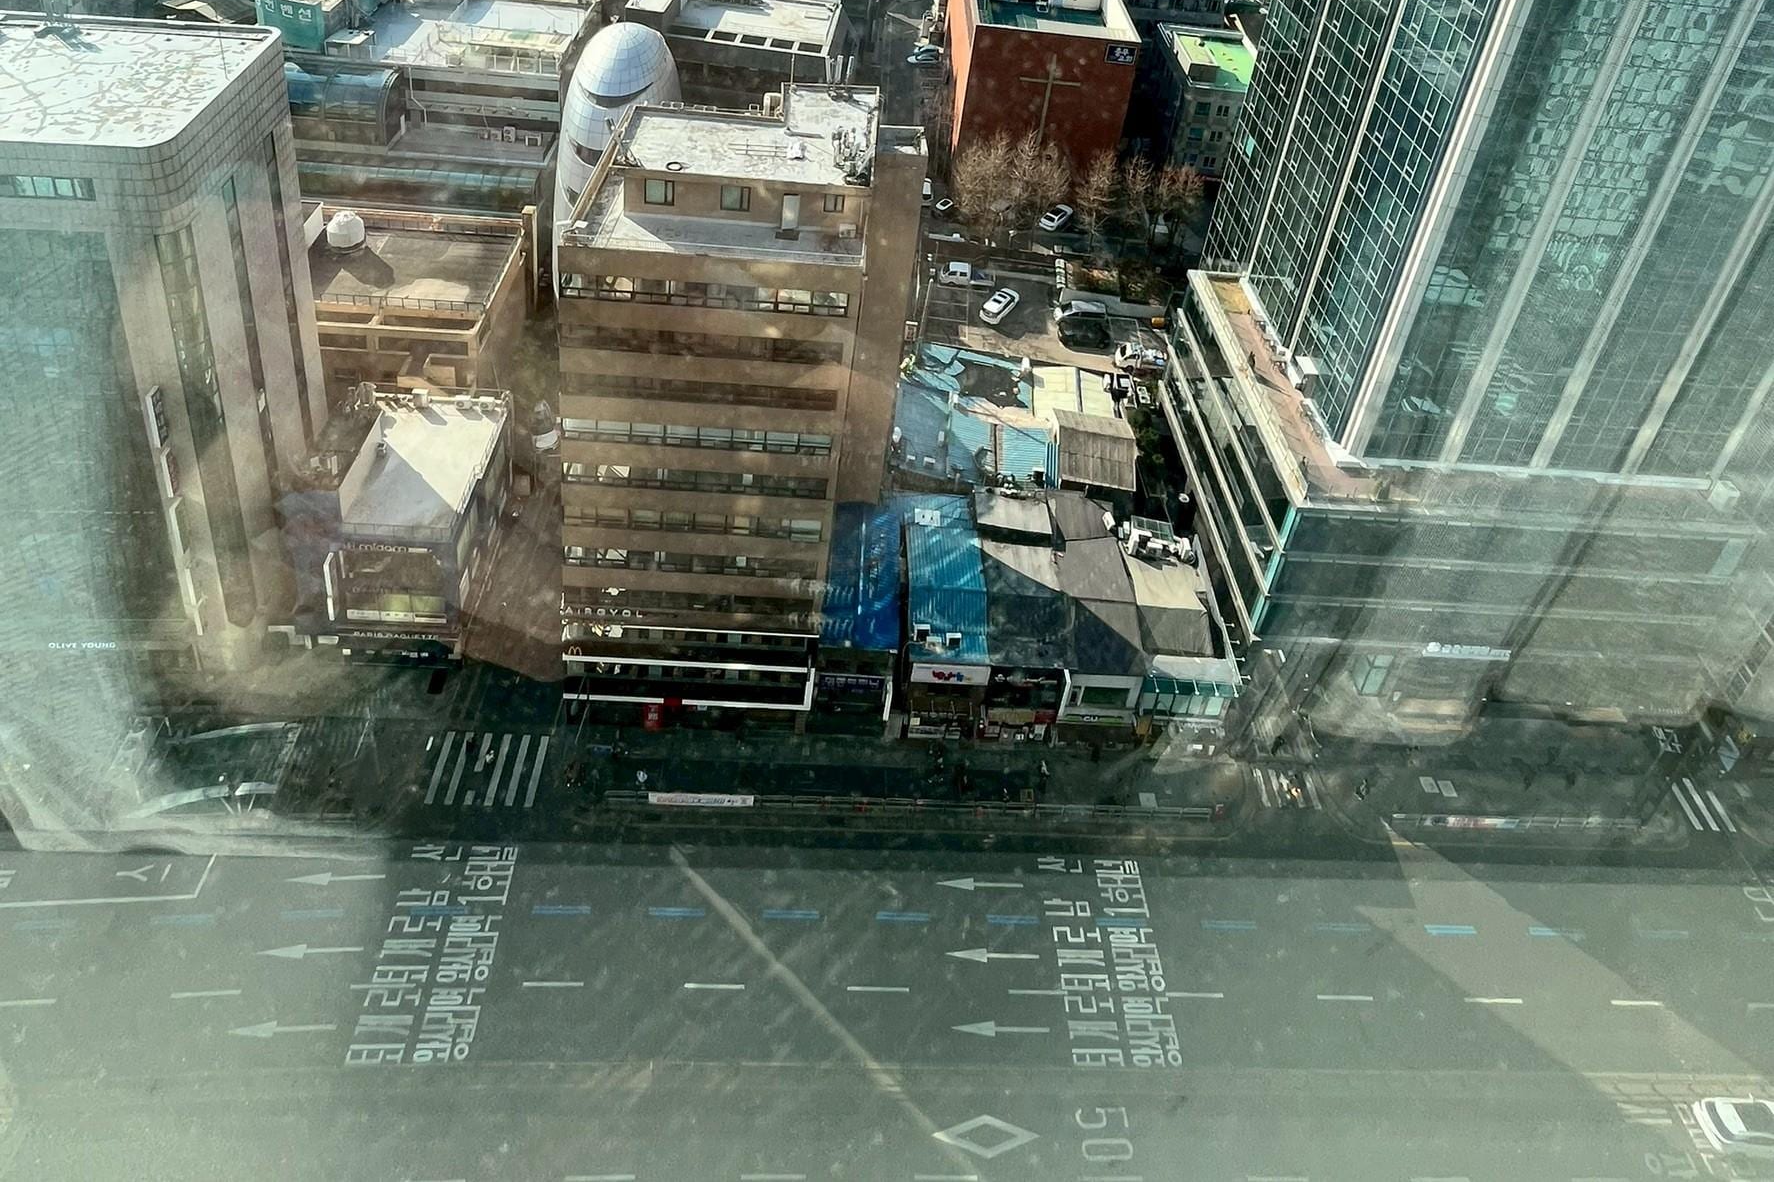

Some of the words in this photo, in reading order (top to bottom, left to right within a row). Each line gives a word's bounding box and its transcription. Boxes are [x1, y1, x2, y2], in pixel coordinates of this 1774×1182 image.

[1083, 715, 1098, 723] CU
[371, 916, 444, 984] 퇴계로
[435, 914, 503, 983] 왕십리역
[1052, 925, 1112, 992] 퇴계로
[1107, 926, 1167, 993] 왕십리역
[345, 988, 422, 1065] 퇴계로
[412, 987, 487, 1064] 왕십리역
[1063, 995, 1126, 1068] 퇴계로
[1121, 995, 1184, 1068] 왕십리역
[1074, 1106, 1134, 1162] 50
